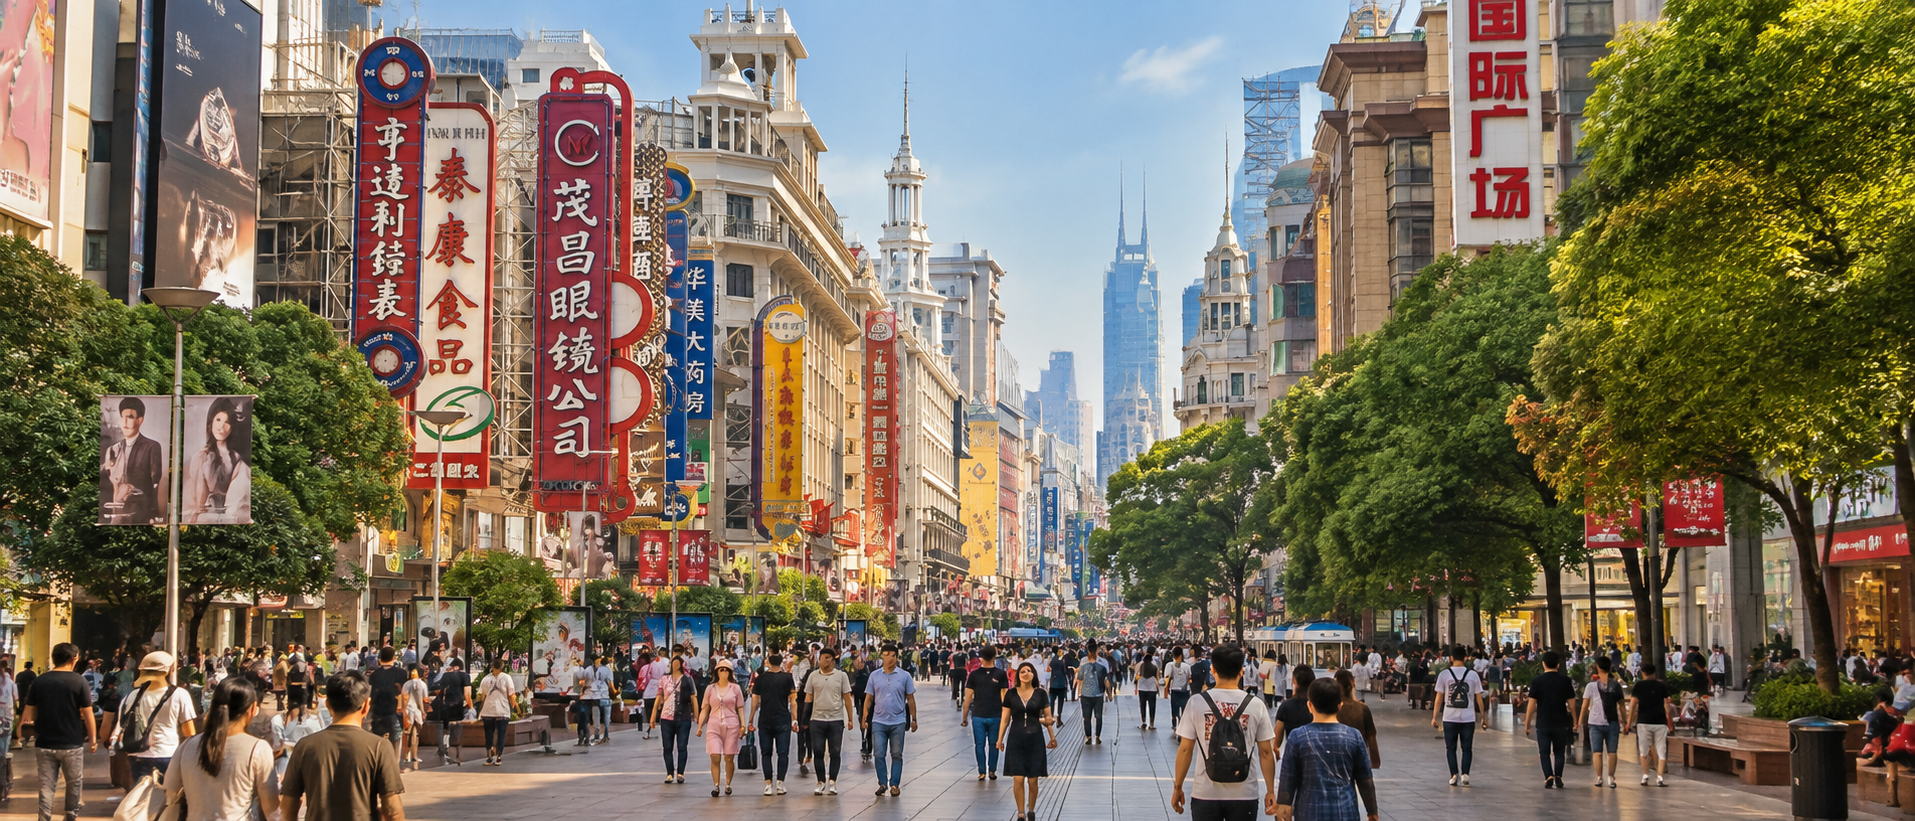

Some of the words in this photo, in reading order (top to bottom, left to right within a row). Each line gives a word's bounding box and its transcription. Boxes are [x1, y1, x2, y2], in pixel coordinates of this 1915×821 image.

[1468, 0, 1531, 219] 国际广场
[425, 147, 481, 376] 泰康食品
